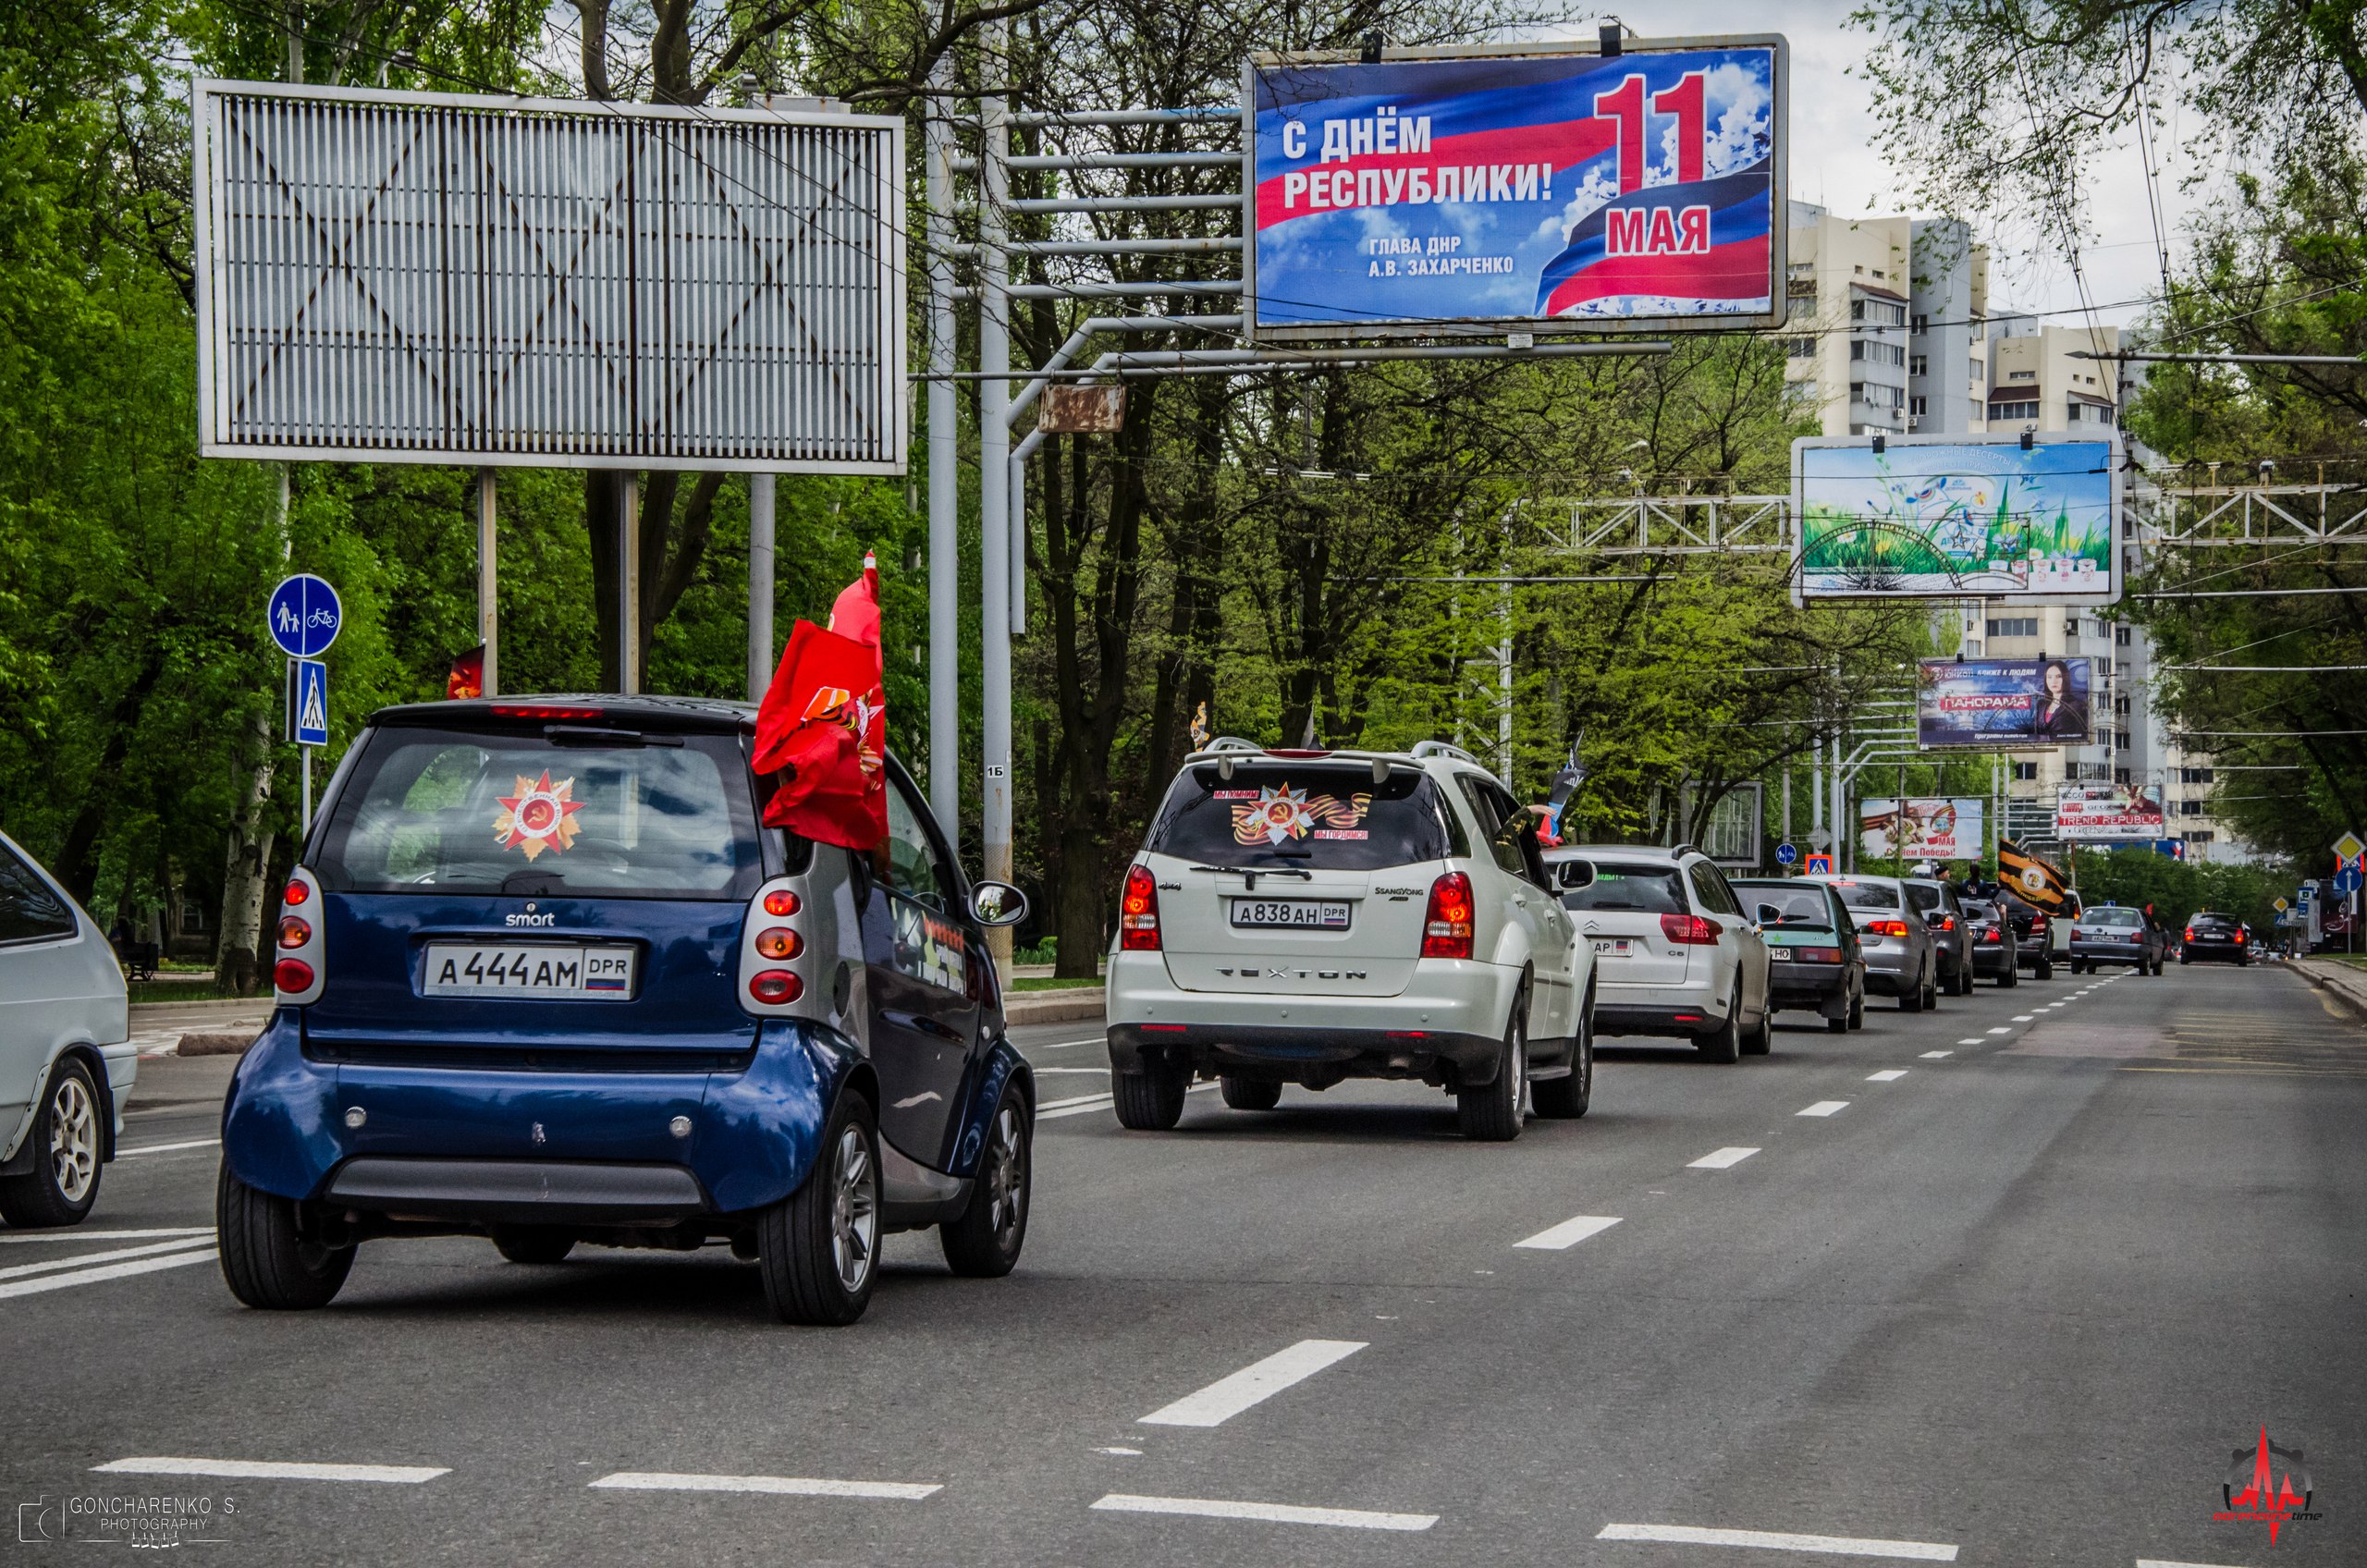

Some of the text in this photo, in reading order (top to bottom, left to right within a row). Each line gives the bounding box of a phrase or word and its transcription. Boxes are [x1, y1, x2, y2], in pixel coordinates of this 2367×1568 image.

[1282, 106, 1431, 163] С ДНЁМ
[1594, 72, 1708, 192] 11
[1283, 164, 1553, 208] РЕСПУБЛИКИ!
[1604, 204, 1711, 257] МАЯ
[1369, 236, 1461, 256] ГЛАВА ДНР
[1368, 256, 1514, 277] А.В. ЗАХАРЧЕНКО
[1968, 448, 2012, 466] ДЕСЕРТЫ
[2008, 668, 2037, 677] ЛЮДЯМ
[1944, 697, 2029, 708] ПАНОРАМА
[1214, 790, 1226, 799] МЫ
[2062, 815, 2160, 826] TREND REPUBLIC
[1315, 830, 1327, 839] МЫ
[1938, 837, 1956, 846] МАЯ
[1919, 848, 1956, 857] Победы!
[1324, 908, 1345, 917] DPR
[505, 913, 555, 926] smart
[1594, 942, 1611, 952] АР
[589, 959, 627, 974] DPR
[1215, 966, 1367, 980] REXTON
